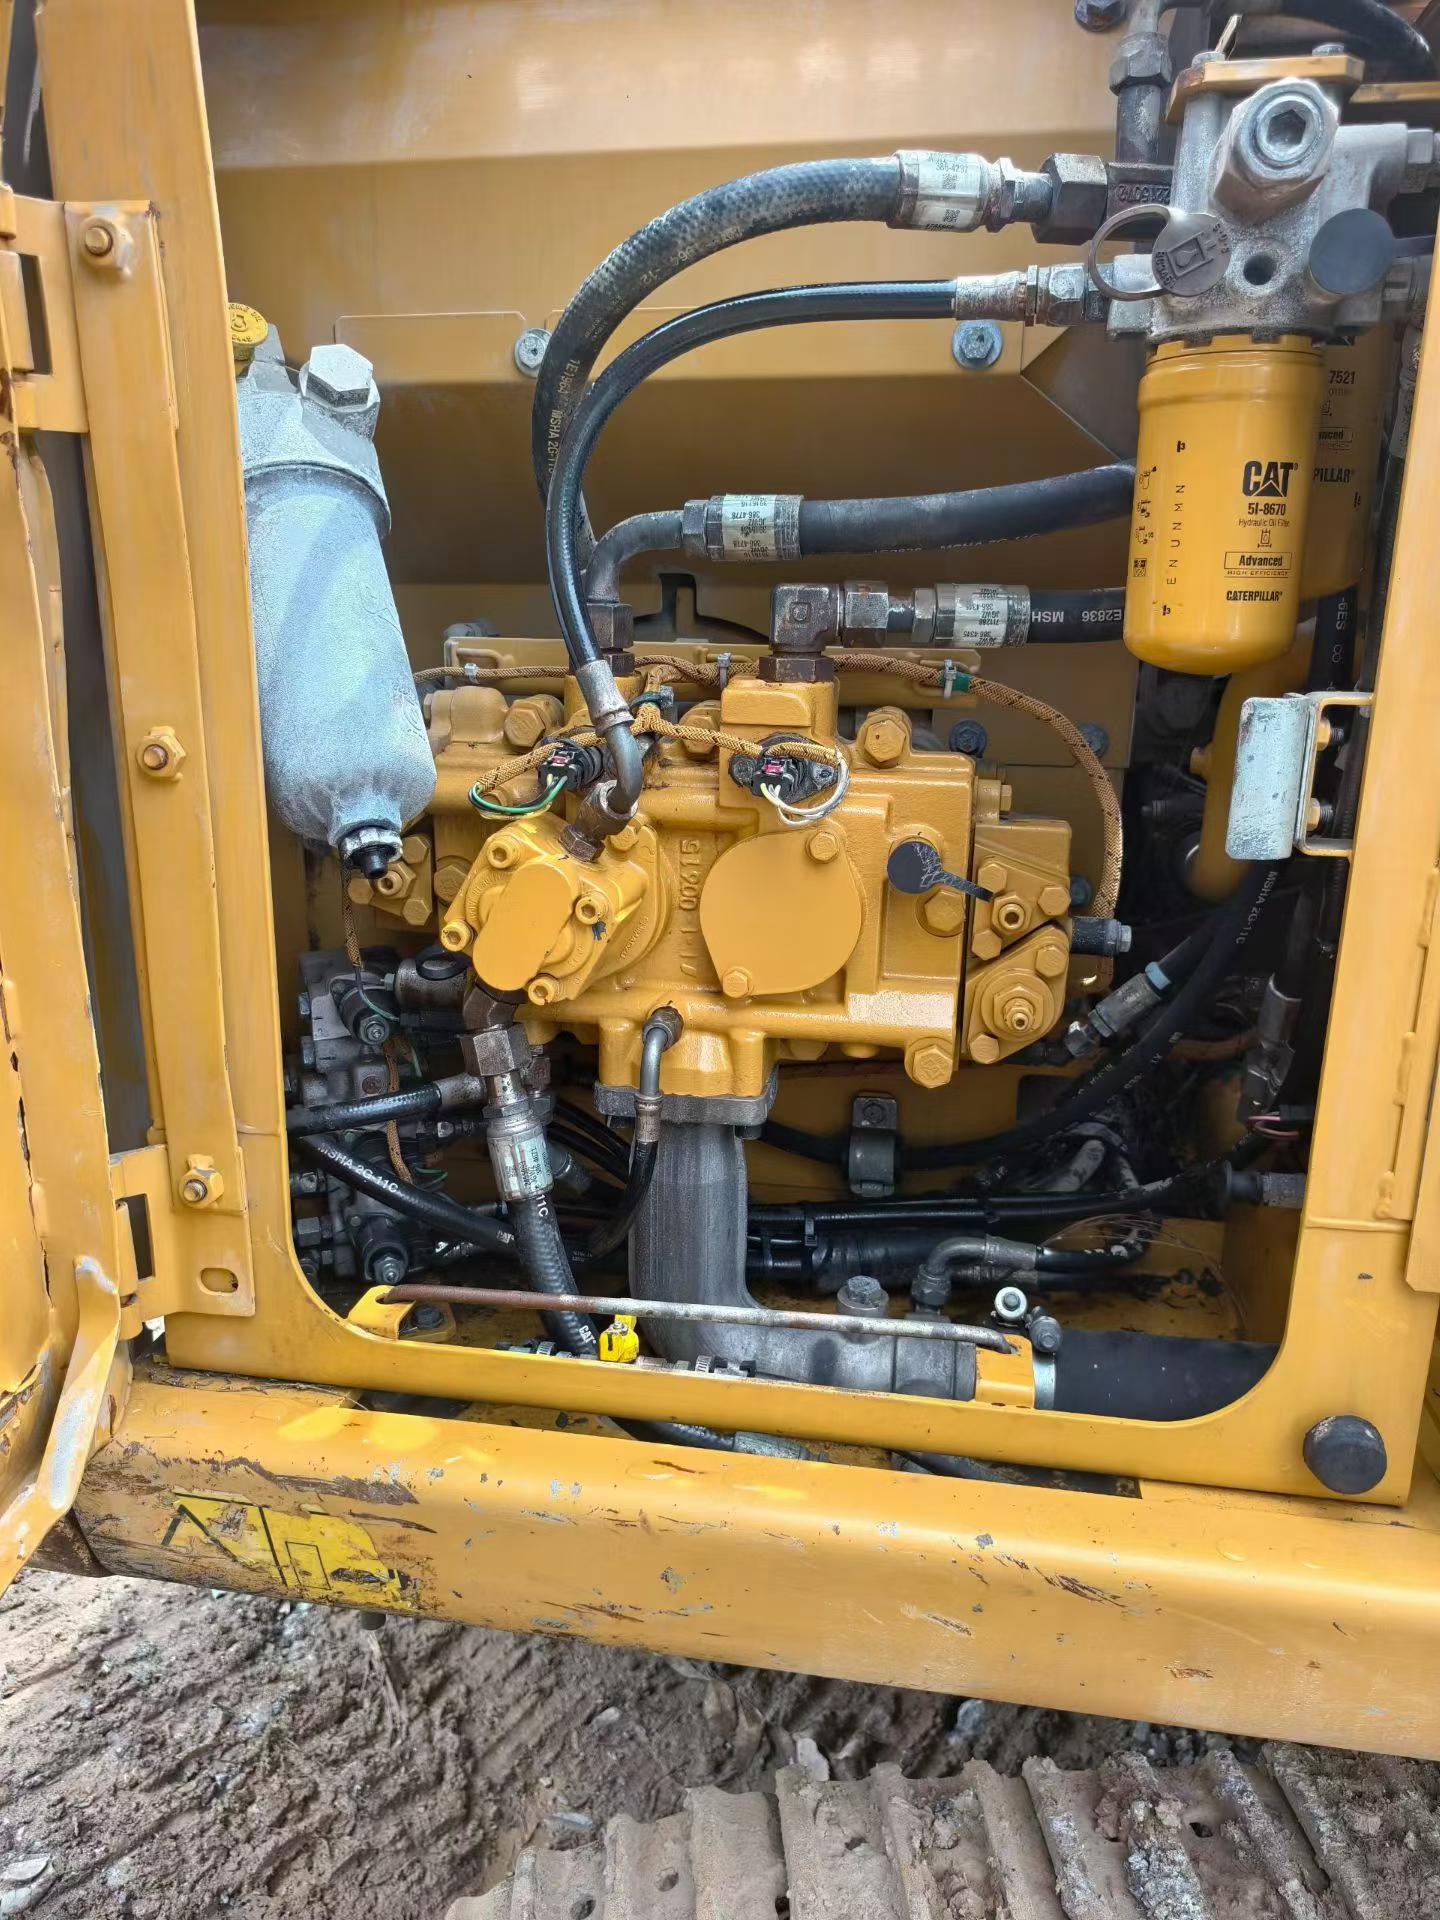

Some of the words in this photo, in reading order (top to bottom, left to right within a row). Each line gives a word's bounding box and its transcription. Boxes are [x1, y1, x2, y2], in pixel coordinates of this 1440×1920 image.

[550, 409, 563, 439] MSHA
[1242, 460, 1294, 497] CAT
[1238, 518, 1267, 528] Hydraulic
[1268, 518, 1277, 527] Oil
[1238, 555, 1283, 567] Advanced
[1226, 590, 1281, 602] CATERPILLAR
[1031, 611, 1065, 623] MSH
[1081, 609, 1122, 622] E2836
[1256, 871, 1280, 905] MSHA
[317, 1143, 354, 1170] MSHA
[354, 1164, 399, 1194] 2G-11C
[579, 1324, 594, 1345] CAT
